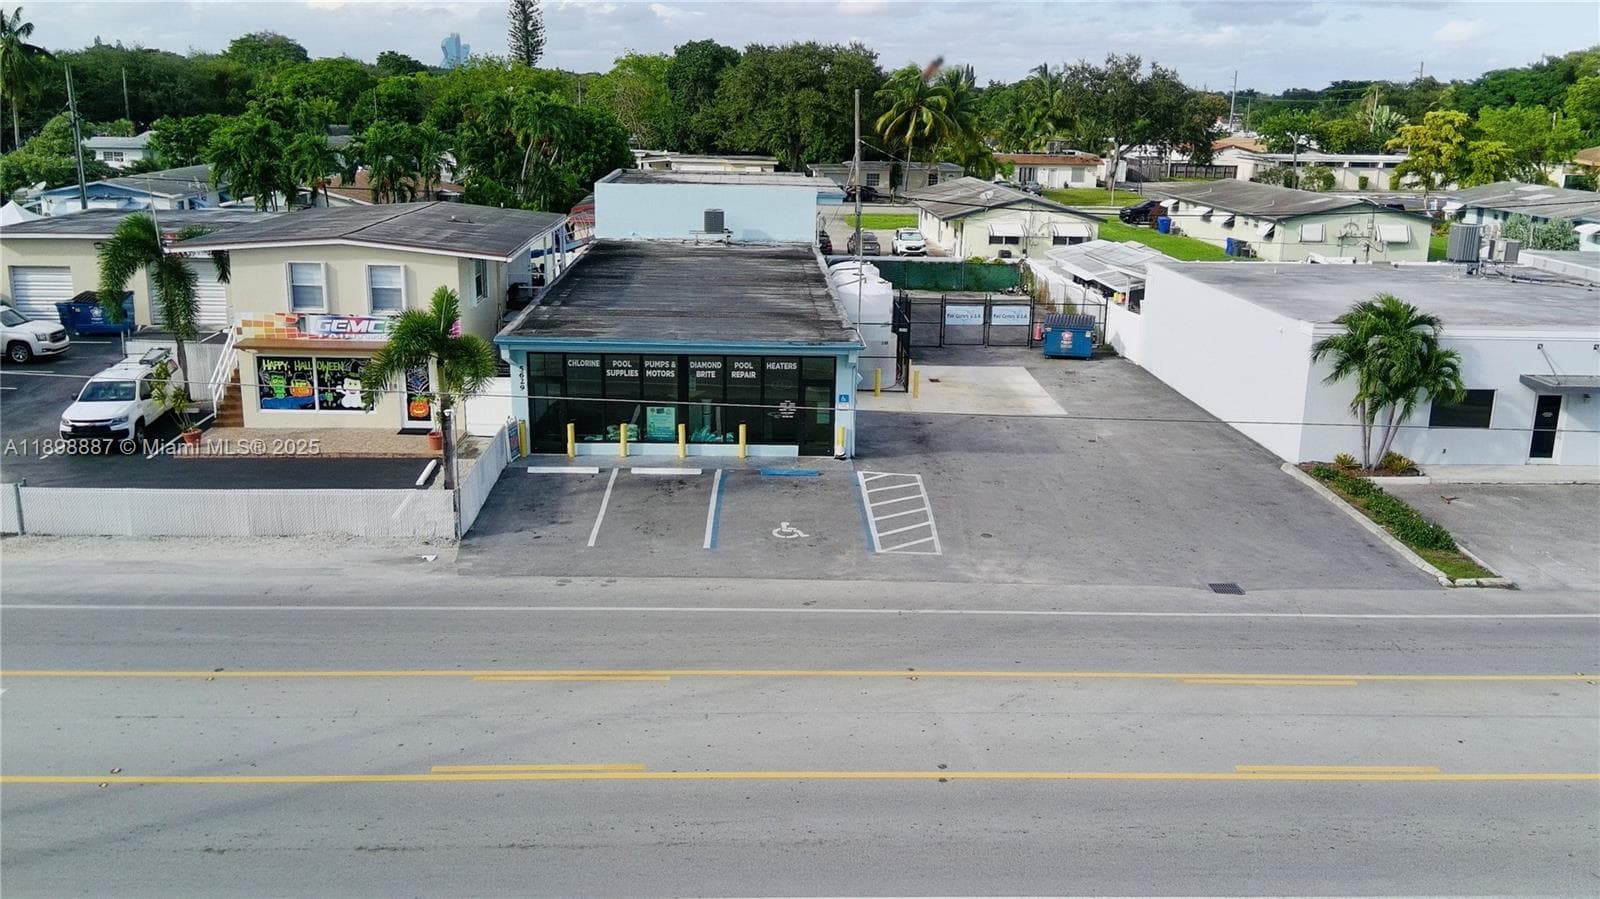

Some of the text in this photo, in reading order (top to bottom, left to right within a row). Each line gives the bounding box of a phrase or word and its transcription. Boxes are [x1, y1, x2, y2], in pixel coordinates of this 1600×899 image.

[766, 362, 797, 370] HEATERS
[606, 369, 639, 377] SUPPLIES
[696, 370, 716, 378] BRITE
